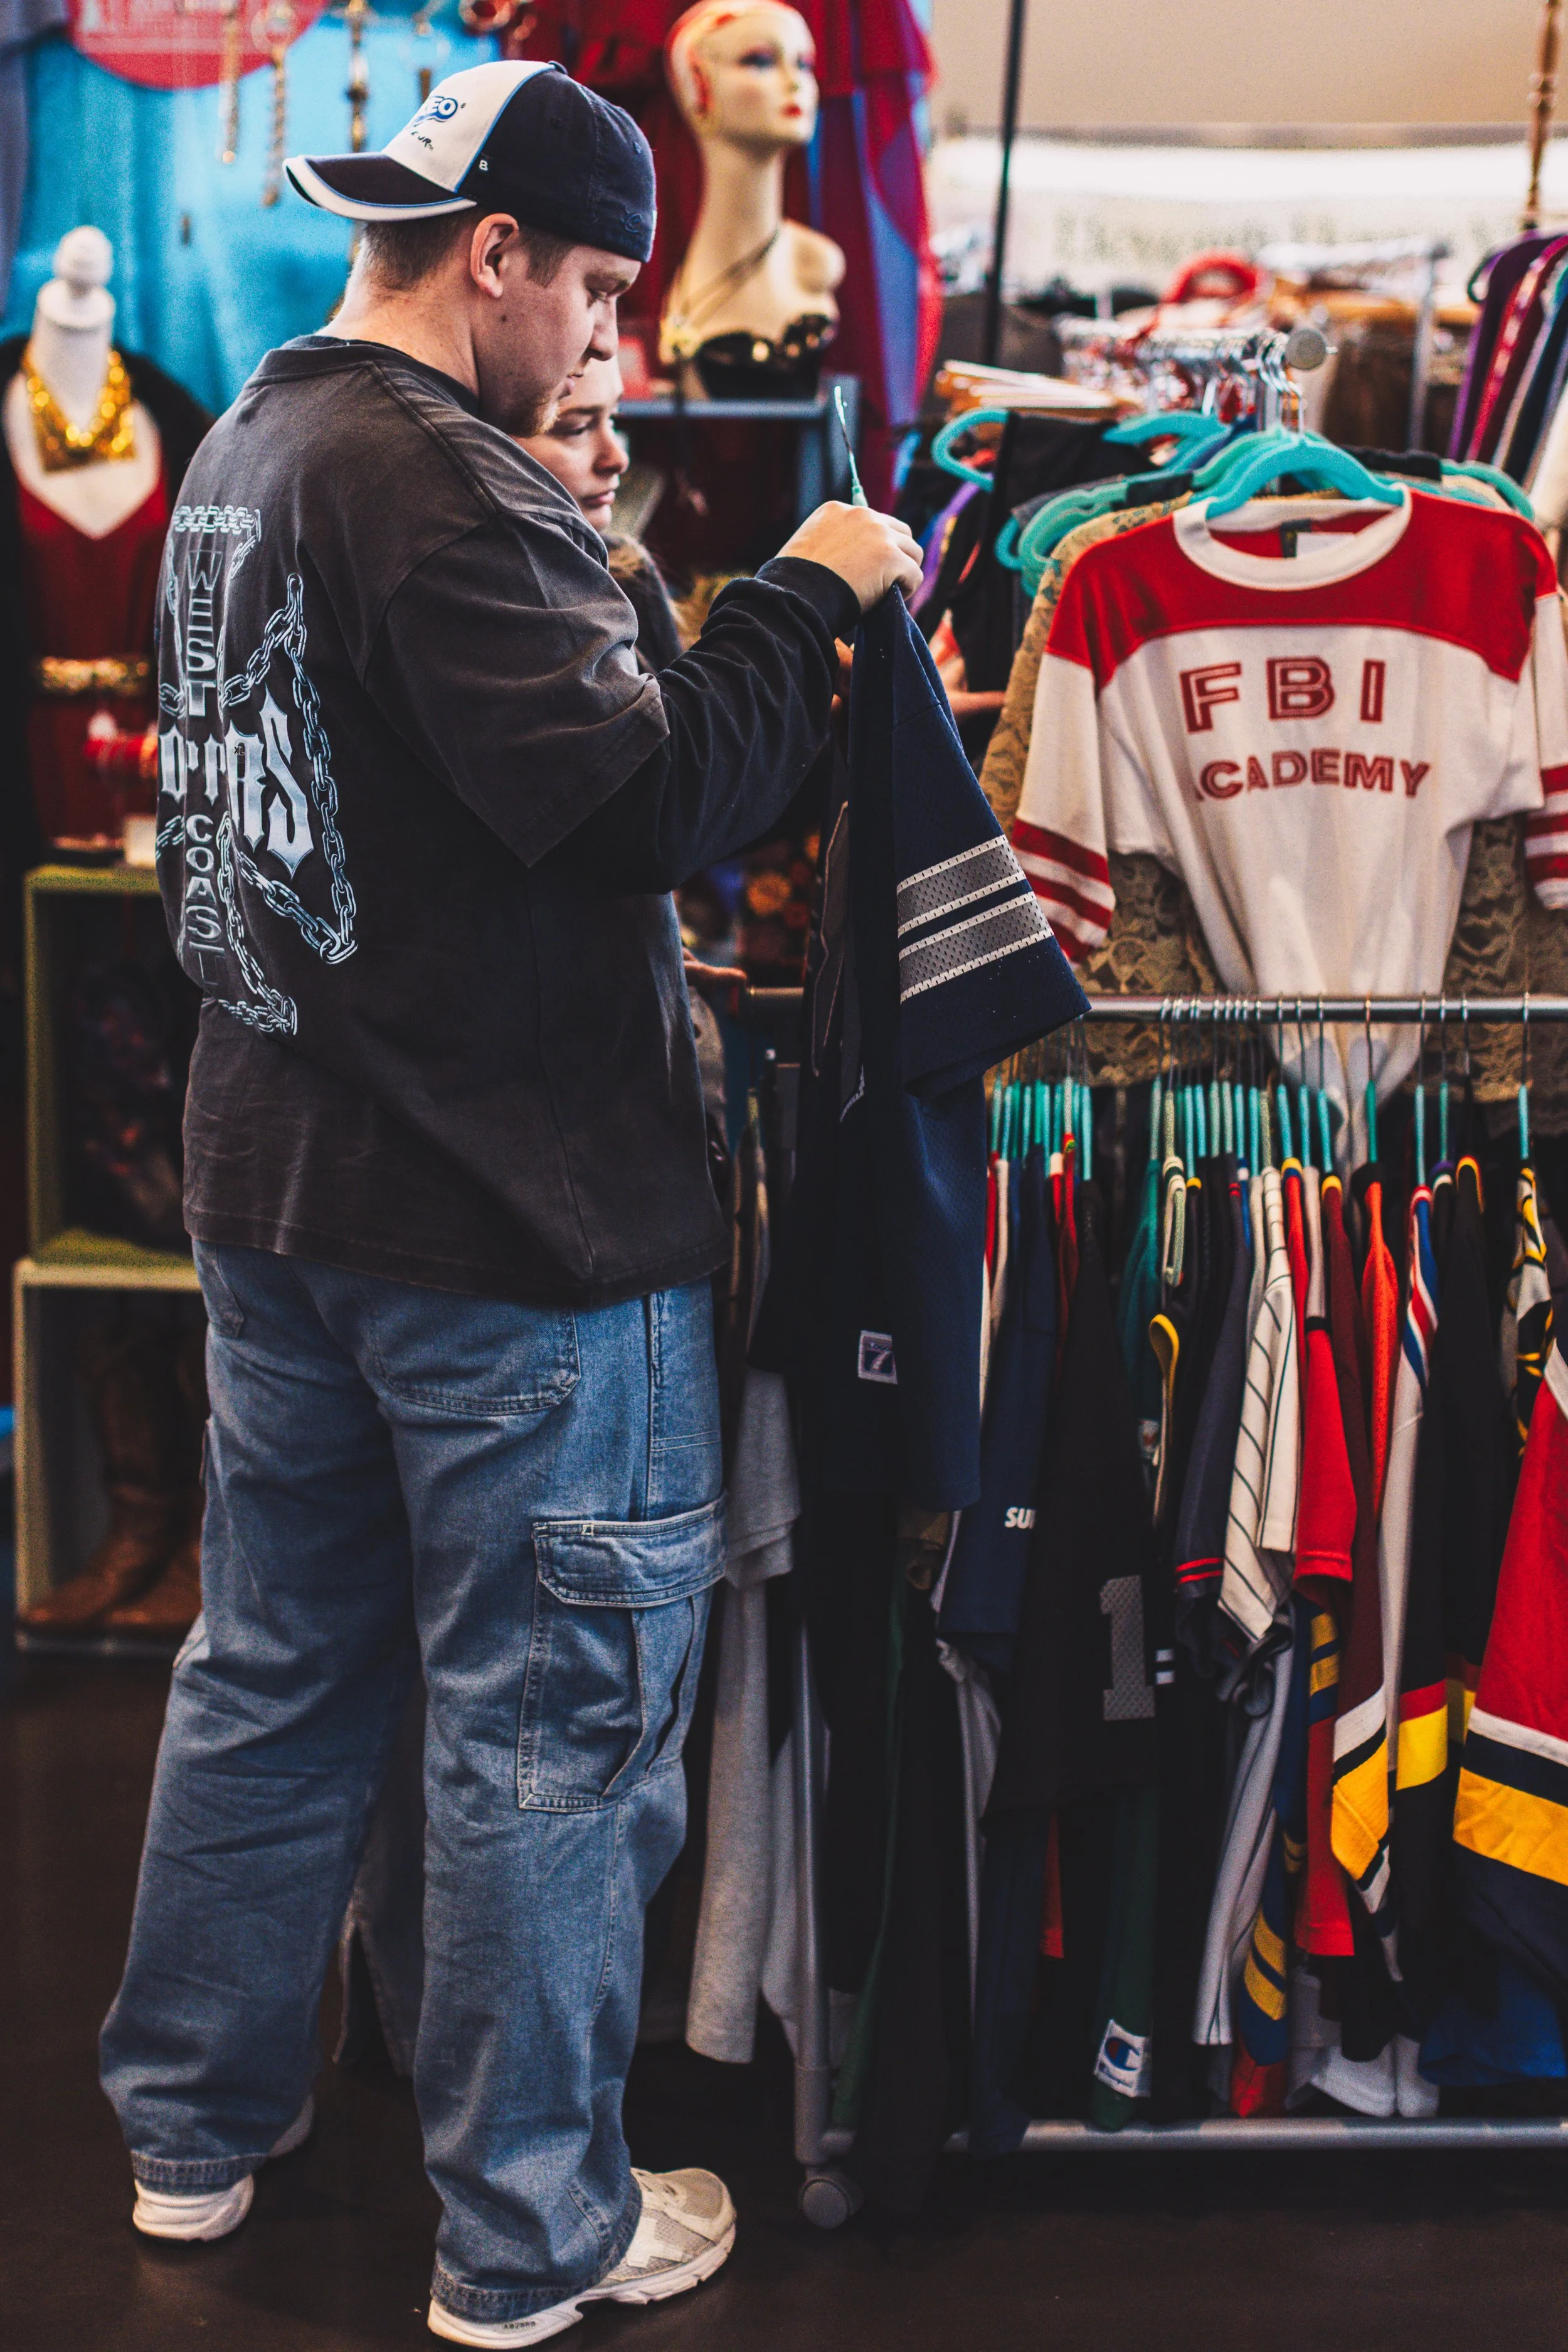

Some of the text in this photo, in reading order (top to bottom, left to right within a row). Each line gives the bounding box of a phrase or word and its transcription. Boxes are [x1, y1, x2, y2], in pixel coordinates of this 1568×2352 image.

[187, 550, 224, 716] WEST
[1179, 655, 1387, 735] FBI
[1195, 748, 1431, 802] CADEMY
[186, 814, 225, 985] COAST
[1099, 1575, 1155, 1720] 1
